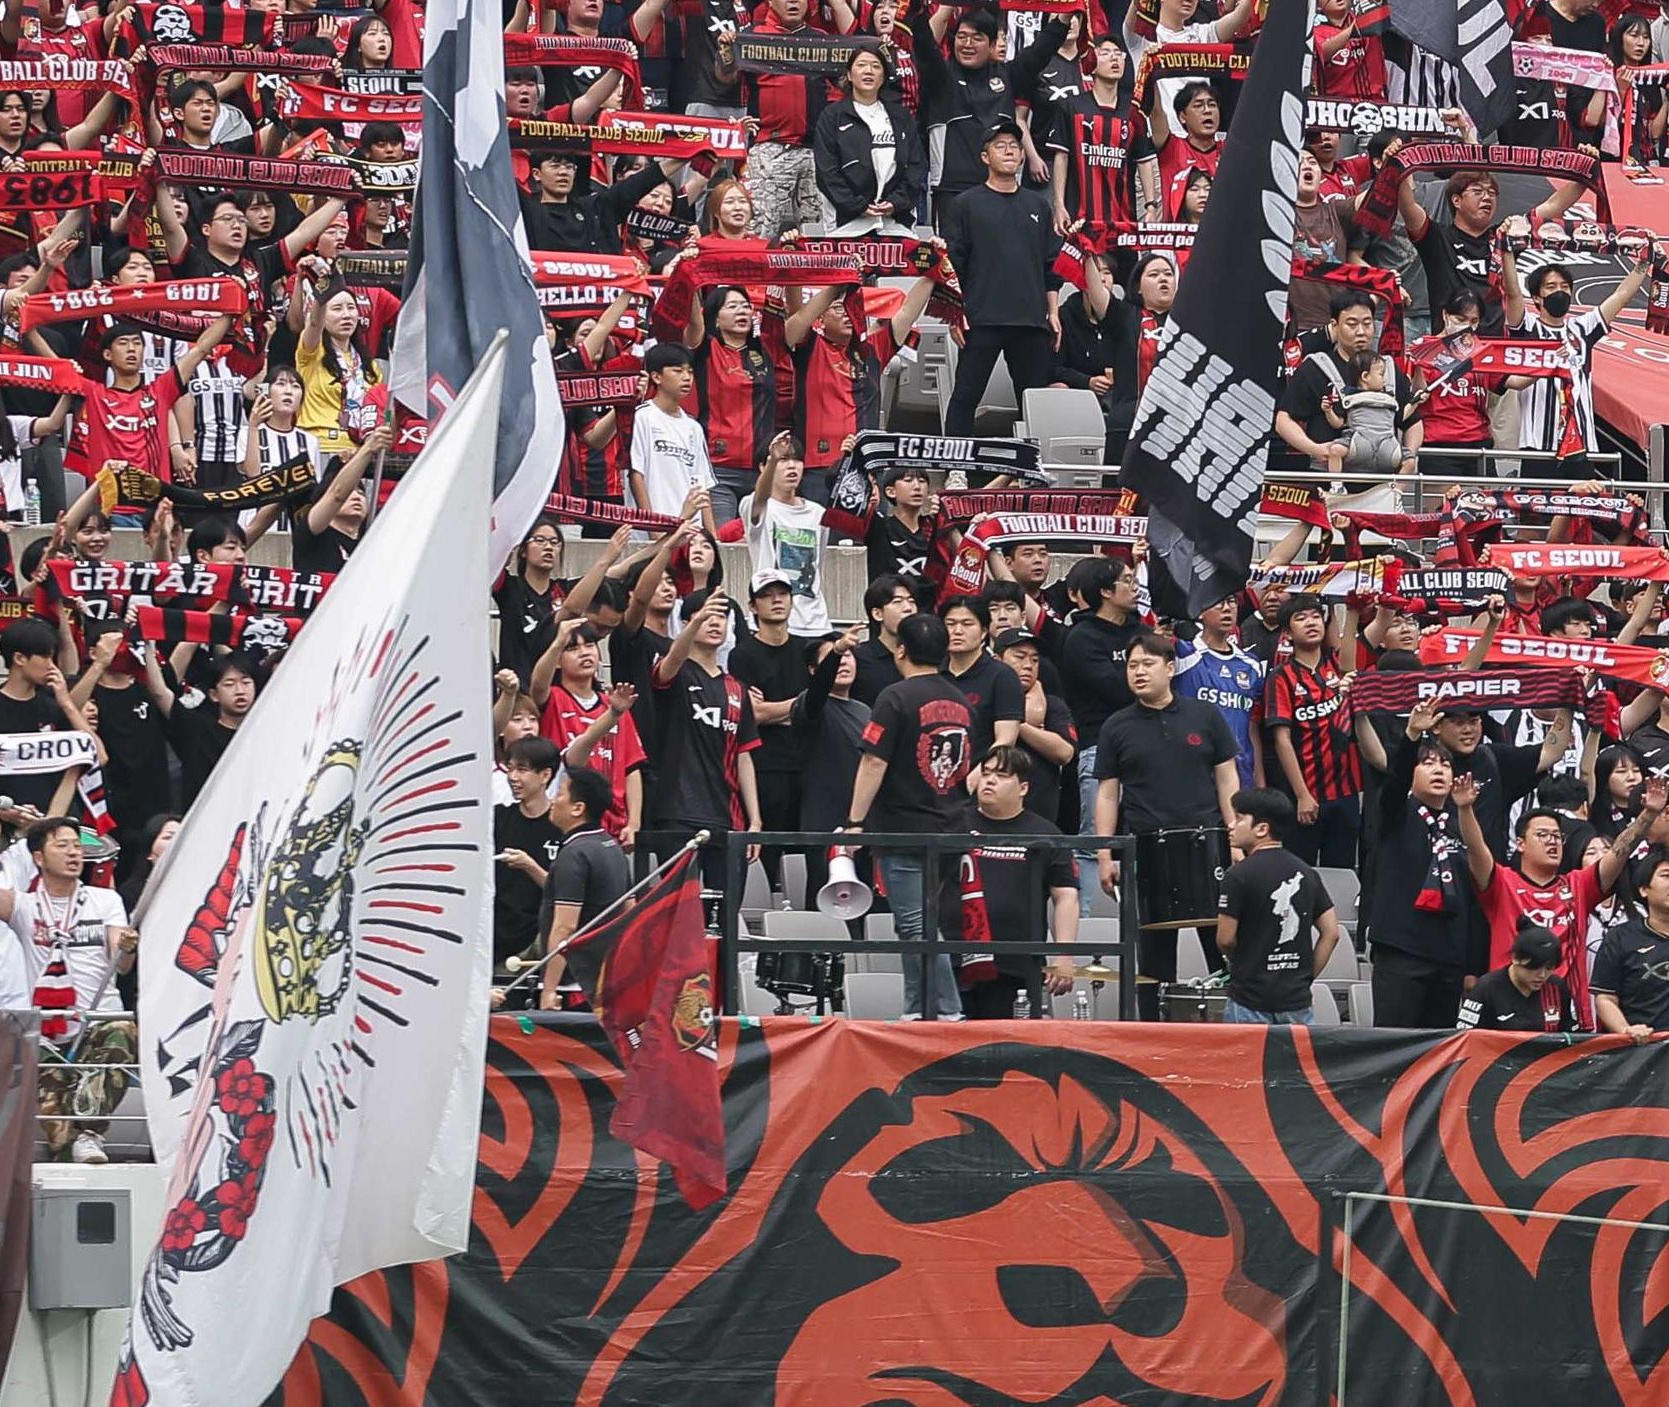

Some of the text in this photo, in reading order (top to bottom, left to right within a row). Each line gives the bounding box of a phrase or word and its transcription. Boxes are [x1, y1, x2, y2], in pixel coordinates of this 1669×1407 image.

[1381, 107, 1444, 130] SHIN
[522, 121, 664, 144] FOOTBALL CLUB SEOUL
[898, 438, 976, 460] FC SEOUL
[1002, 513, 1114, 534] FOOTBALL CLUB
[1512, 550, 1624, 568] FC SEOUL
[70, 569, 219, 595] GRITAR
[1417, 678, 1520, 699] RAPIER
